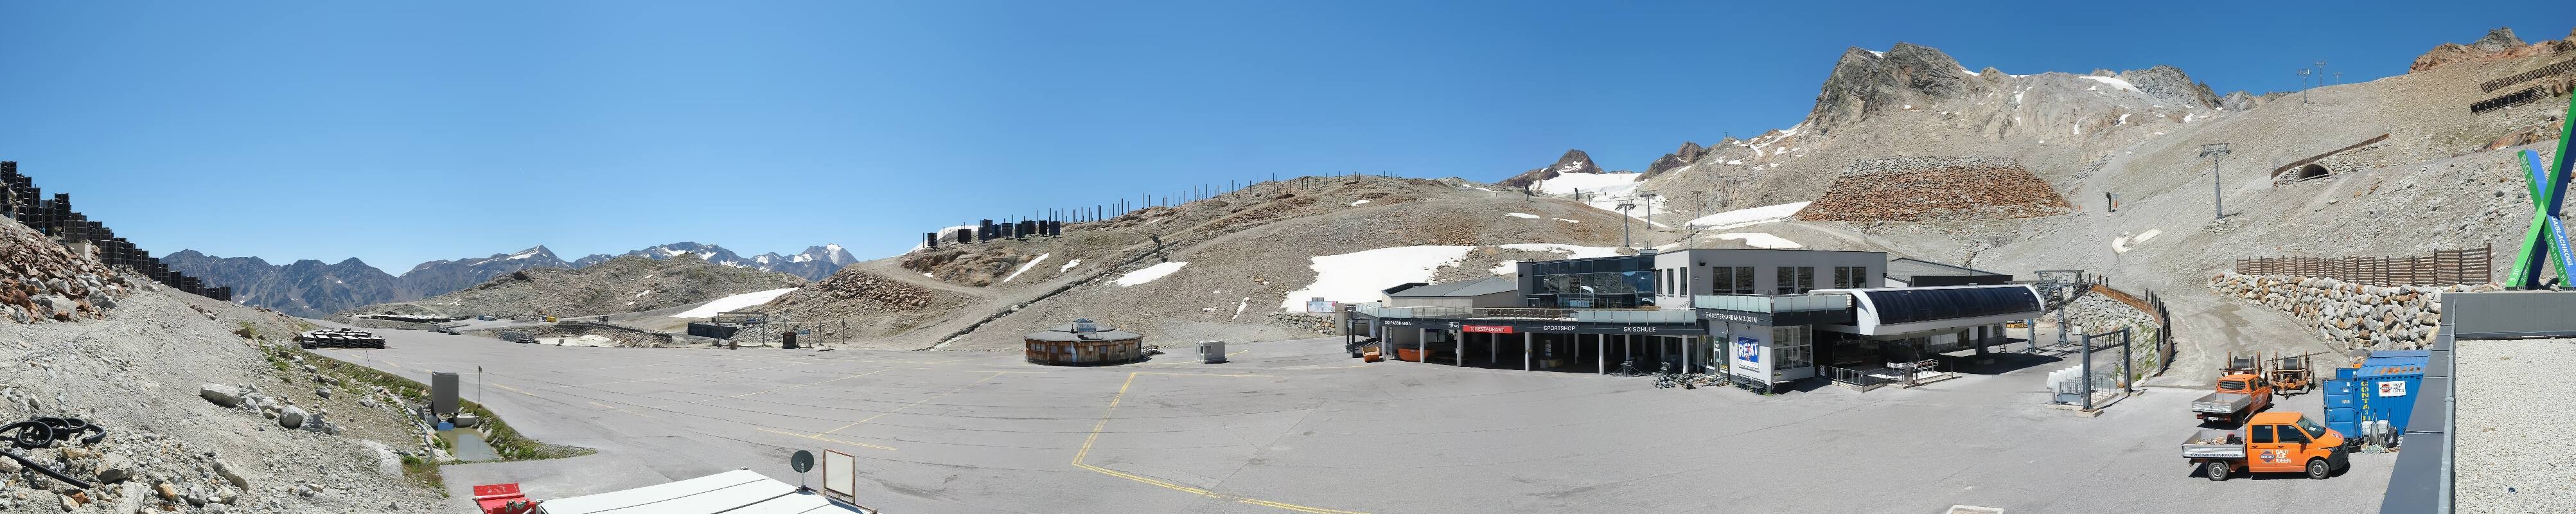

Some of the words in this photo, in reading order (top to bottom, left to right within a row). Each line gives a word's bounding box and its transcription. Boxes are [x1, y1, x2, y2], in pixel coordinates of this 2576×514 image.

[2520, 154, 2530, 175] BIG
[2527, 175, 2534, 184] 3
[2551, 216, 2573, 267] GAISLACHKOGL
[2510, 266, 2520, 283] 3.30
[1711, 313, 1742, 321] SEITERKARBAHN
[1738, 343, 1758, 357] RENT
